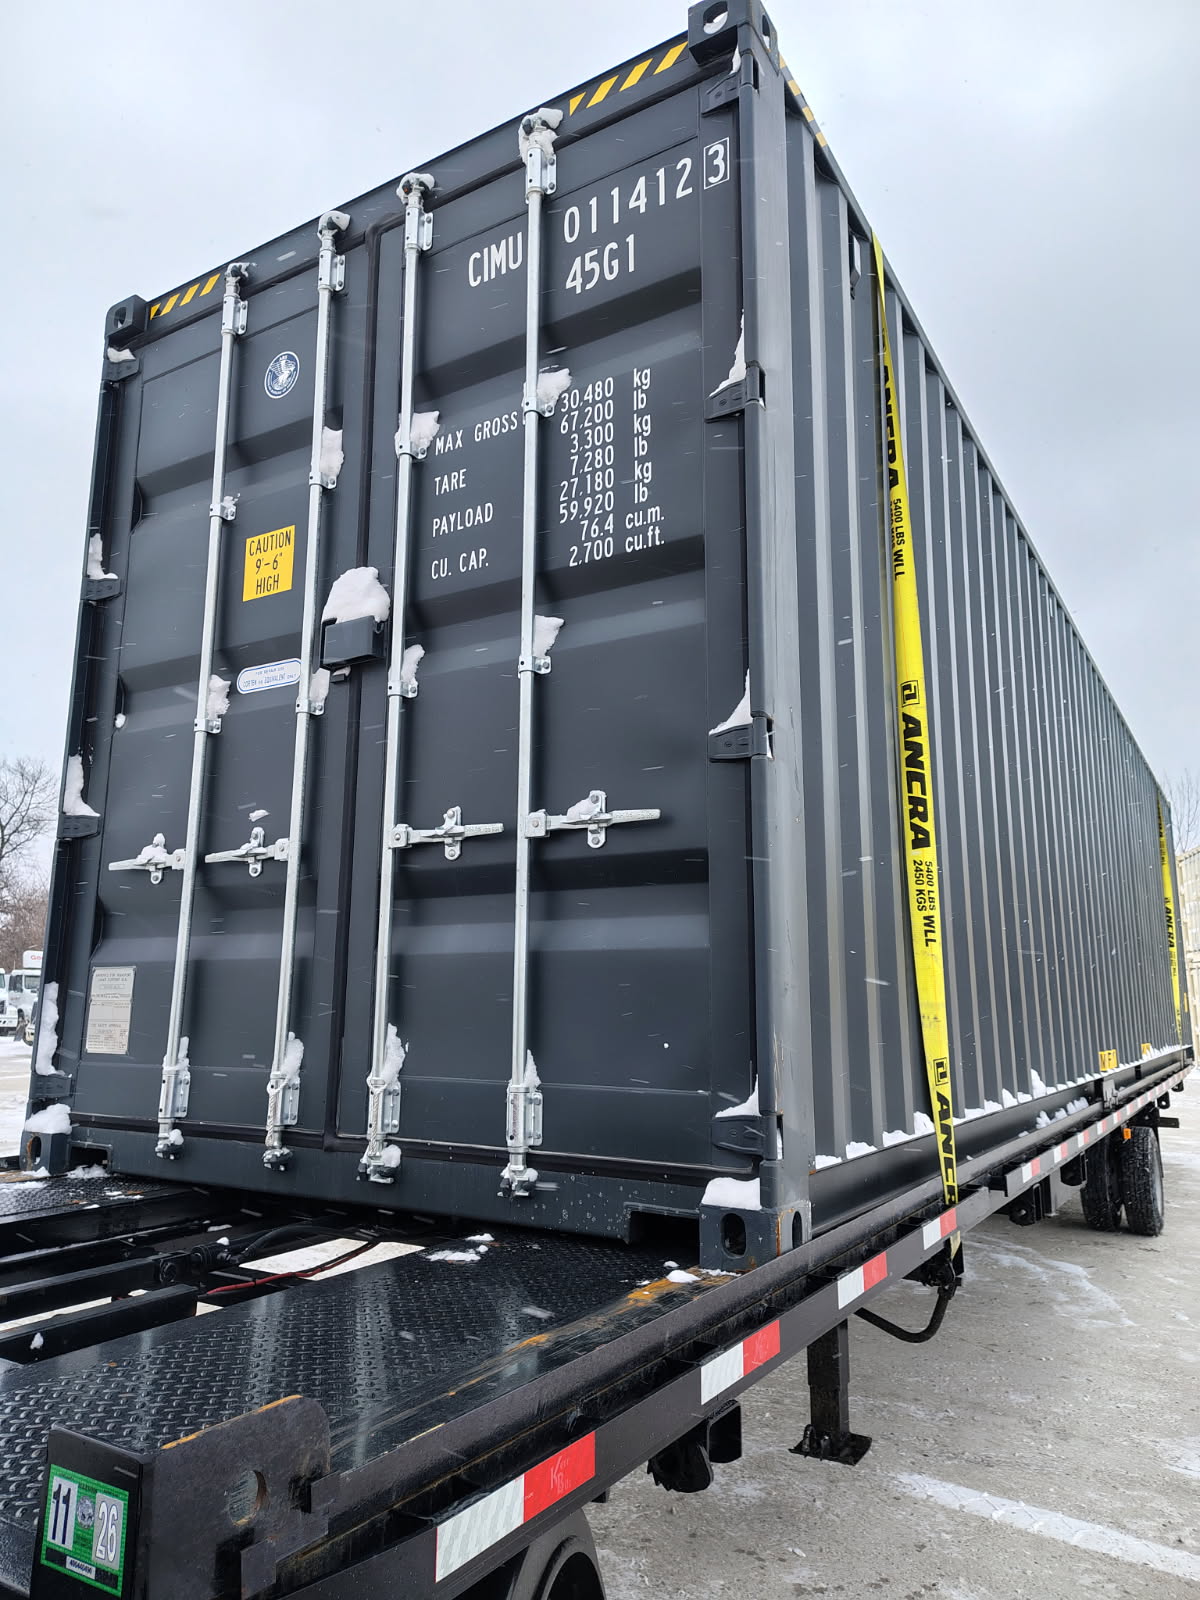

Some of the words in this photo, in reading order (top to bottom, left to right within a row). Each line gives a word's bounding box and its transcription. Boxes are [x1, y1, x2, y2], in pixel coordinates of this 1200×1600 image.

[469, 231, 522, 287] CIMU
[564, 157, 692, 243] 011412
[708, 143, 725, 184] 3
[566, 234, 635, 294] 45G1
[435, 429, 463, 456] MAX
[474, 411, 518, 442] GROSS
[561, 377, 613, 412] 30,480
[633, 368, 651, 390] kg
[560, 400, 613, 434] 67,200
[633, 389, 647, 411] lb
[434, 469, 467, 496] TARE
[570, 422, 613, 453] 3,300
[633, 413, 651, 436] kg
[570, 445, 614, 476] 7,280
[634, 435, 648, 458] lb
[432, 502, 493, 537] PAYLOAD
[560, 468, 614, 501] 27,180
[634, 460, 652, 483] kg
[560, 491, 614, 524] 59,920
[634, 482, 648, 504] lb
[894, 498, 903, 523] 5400
[249, 529, 292, 556] CAUTION
[431, 558, 452, 580] CU.
[459, 548, 489, 573] CAP.
[580, 513, 613, 541] 76.4
[625, 506, 665, 529] cu.m.
[569, 537, 613, 567] 2,700
[625, 525, 665, 553] cu.ft.
[896, 526, 905, 546] LBS
[256, 573, 280, 595] HIGH
[894, 549, 905, 581] WLL
[902, 711, 931, 850] ANCRA
[913, 860, 925, 886] 2450
[925, 861, 935, 887] 5400
[916, 889, 927, 912] KGS
[928, 890, 937, 911] LBS
[923, 915, 937, 947] WLL
[52, 1484, 71, 1545] 11
[96, 1501, 118, 1562] 26
